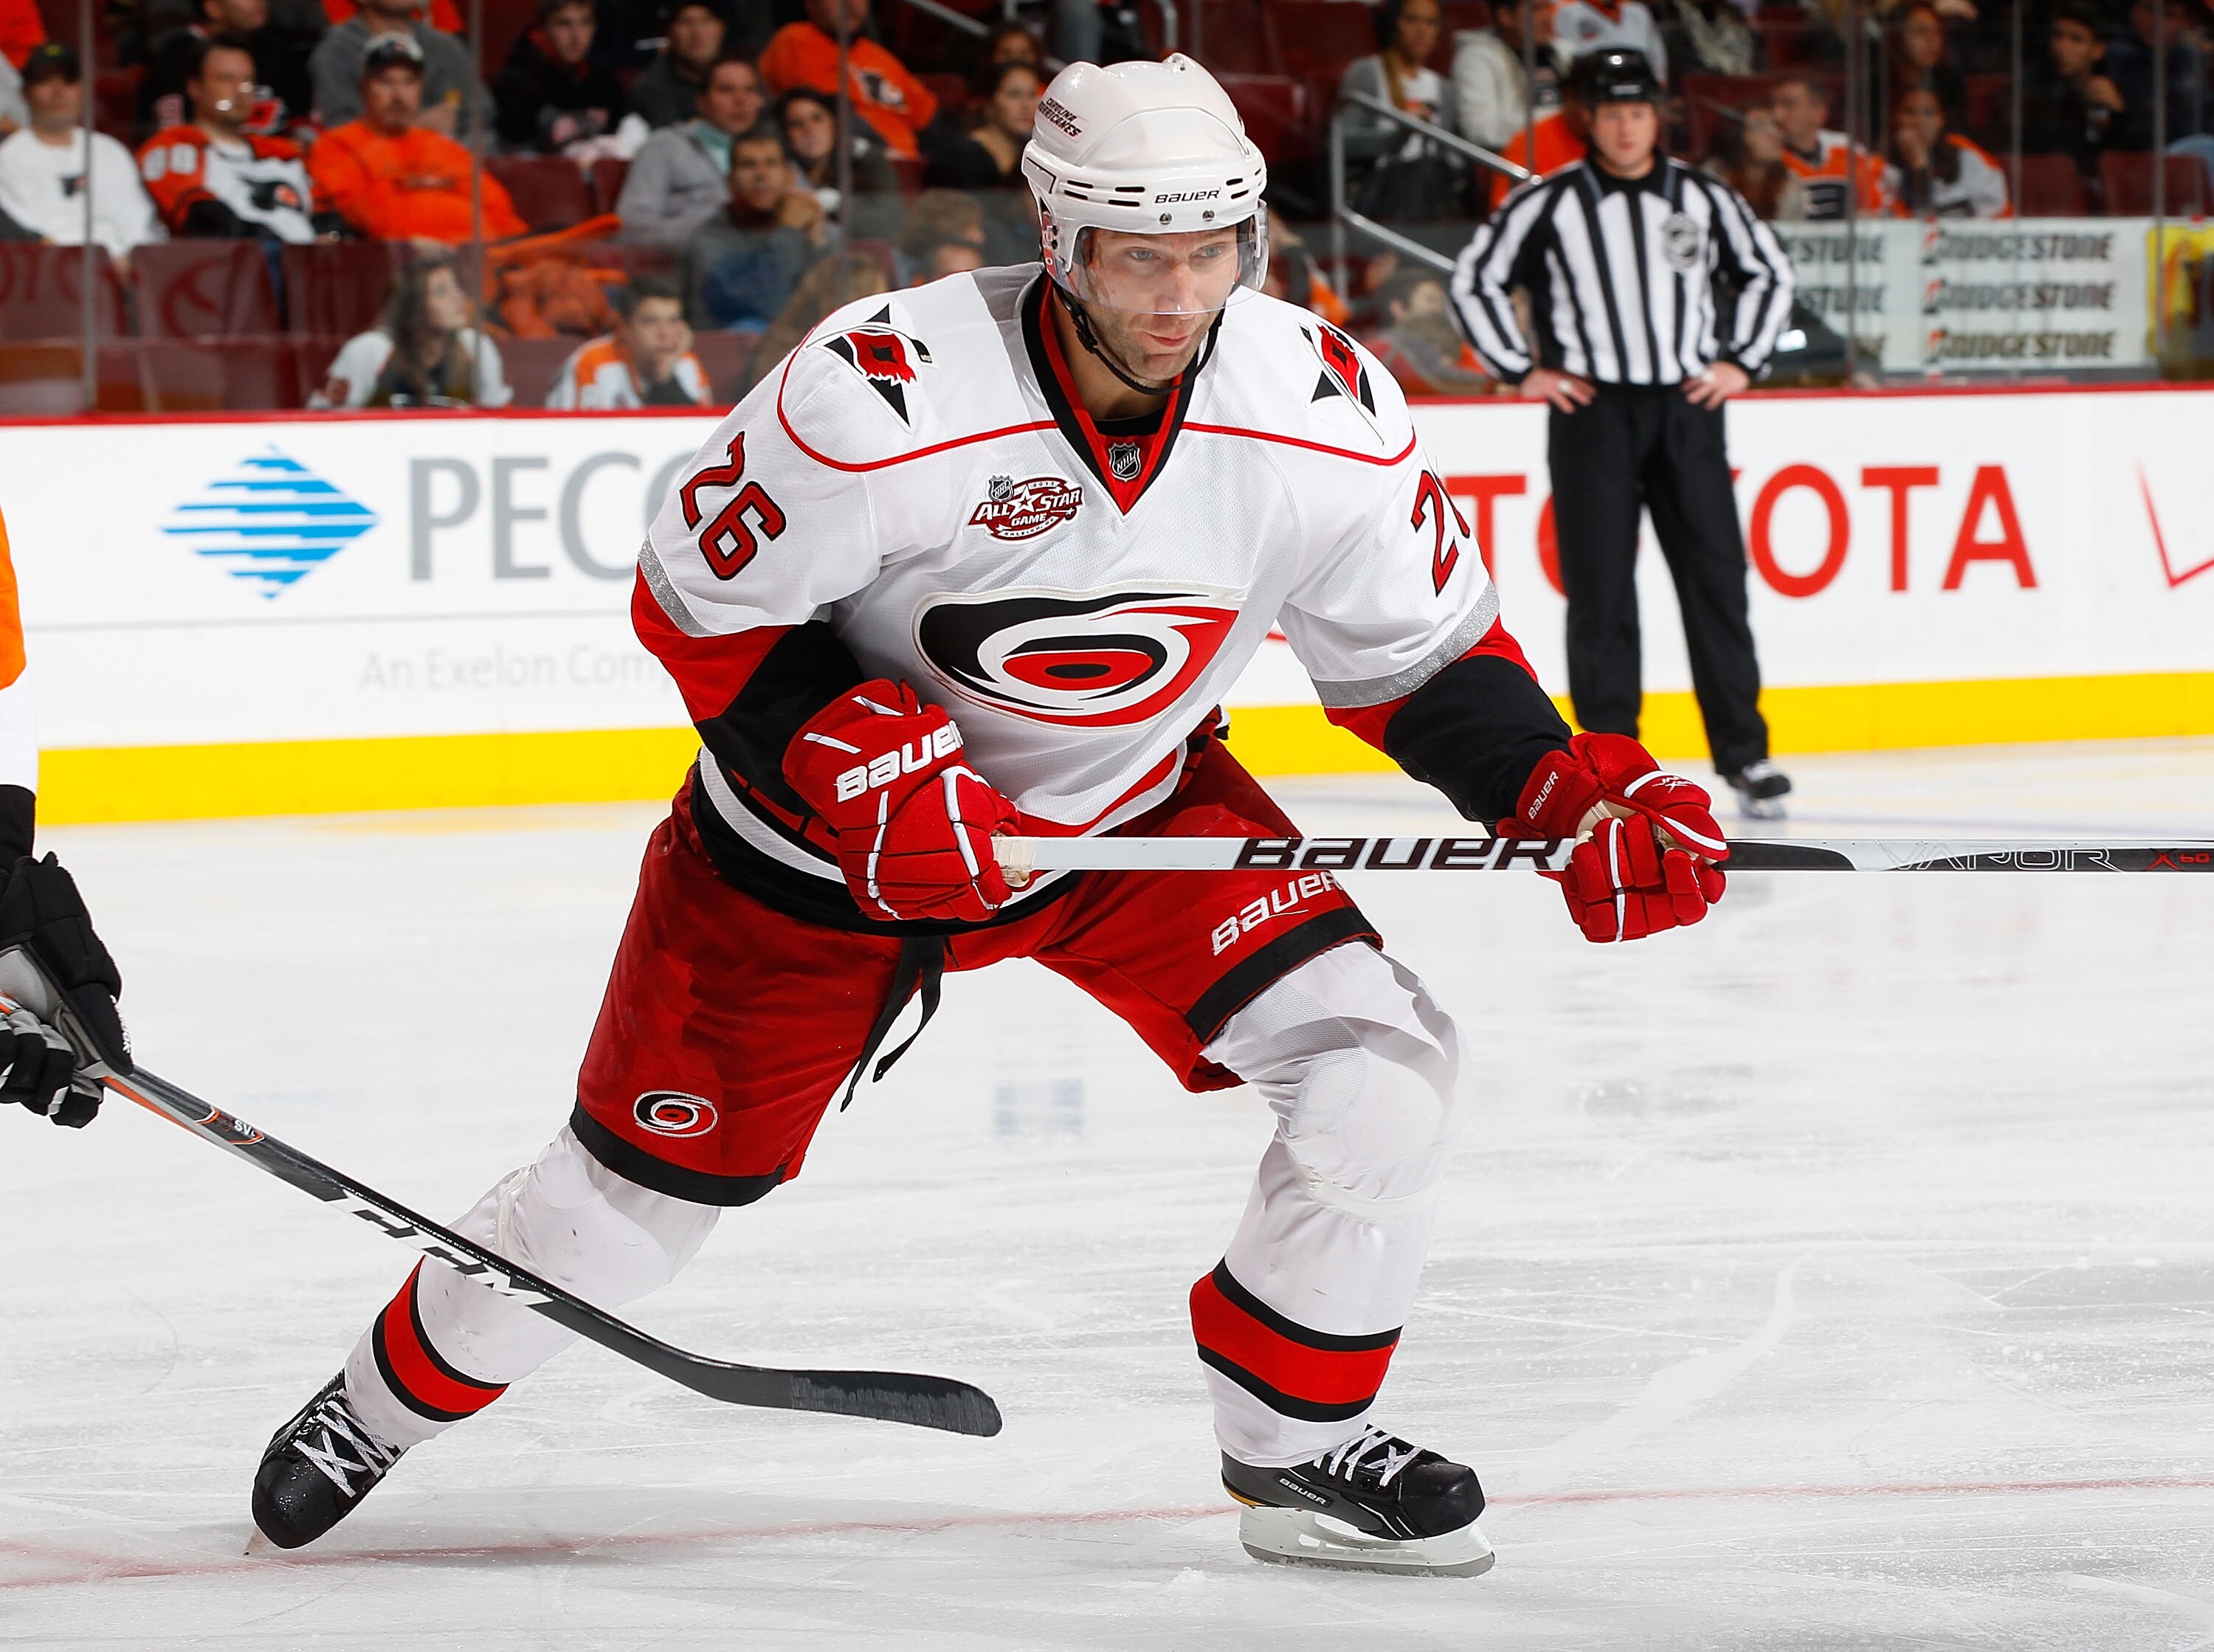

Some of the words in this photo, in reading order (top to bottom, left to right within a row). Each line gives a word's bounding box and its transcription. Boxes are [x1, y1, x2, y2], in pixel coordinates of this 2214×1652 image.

[1117, 450, 1137, 473] NHL
[680, 431, 787, 581] 26
[974, 503, 1011, 521] ALL
[1035, 489, 1081, 512] STAR
[994, 481, 1010, 498] NHL
[408, 449, 701, 583] PEC
[1011, 513, 1047, 527] GAME
[1444, 460, 2038, 599] TOTA
[1410, 470, 1470, 598] 2
[358, 652, 414, 689] An
[1874, 839, 2123, 872] VAPOR
